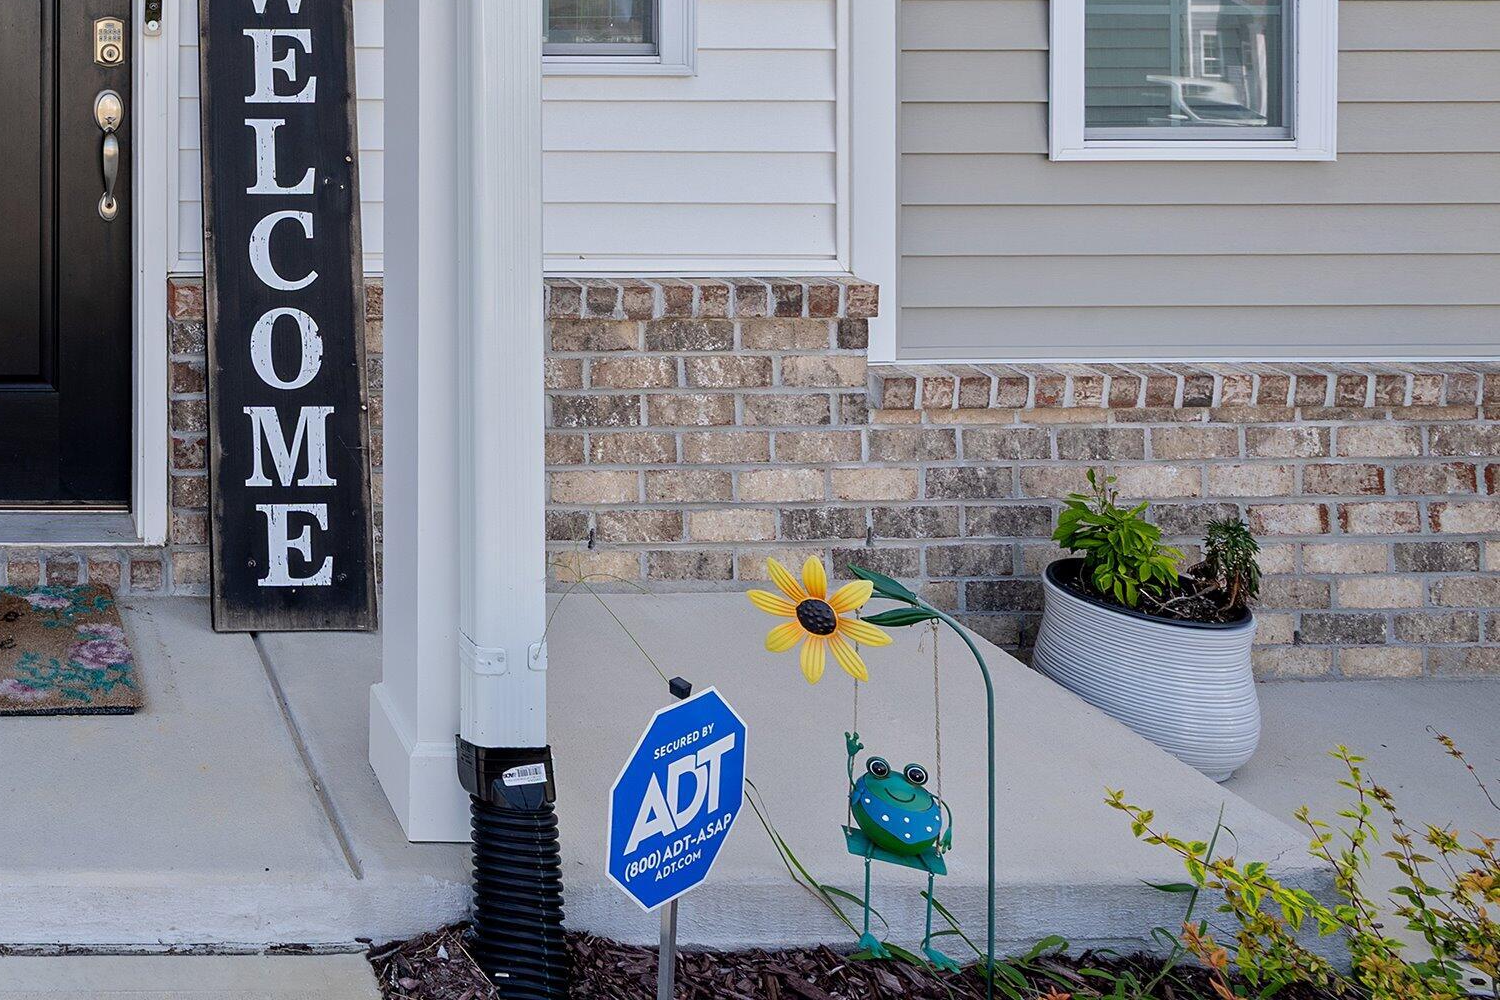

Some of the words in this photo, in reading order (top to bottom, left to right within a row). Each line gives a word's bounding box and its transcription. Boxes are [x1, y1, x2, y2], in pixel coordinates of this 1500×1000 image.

[653, 730, 700, 760] SECURED
[701, 722, 715, 738] BY
[623, 732, 736, 857] ADT
[624, 849, 662, 883] (800)
[662, 812, 733, 863] ADT-ASAP
[654, 848, 702, 883] ADT.COM
